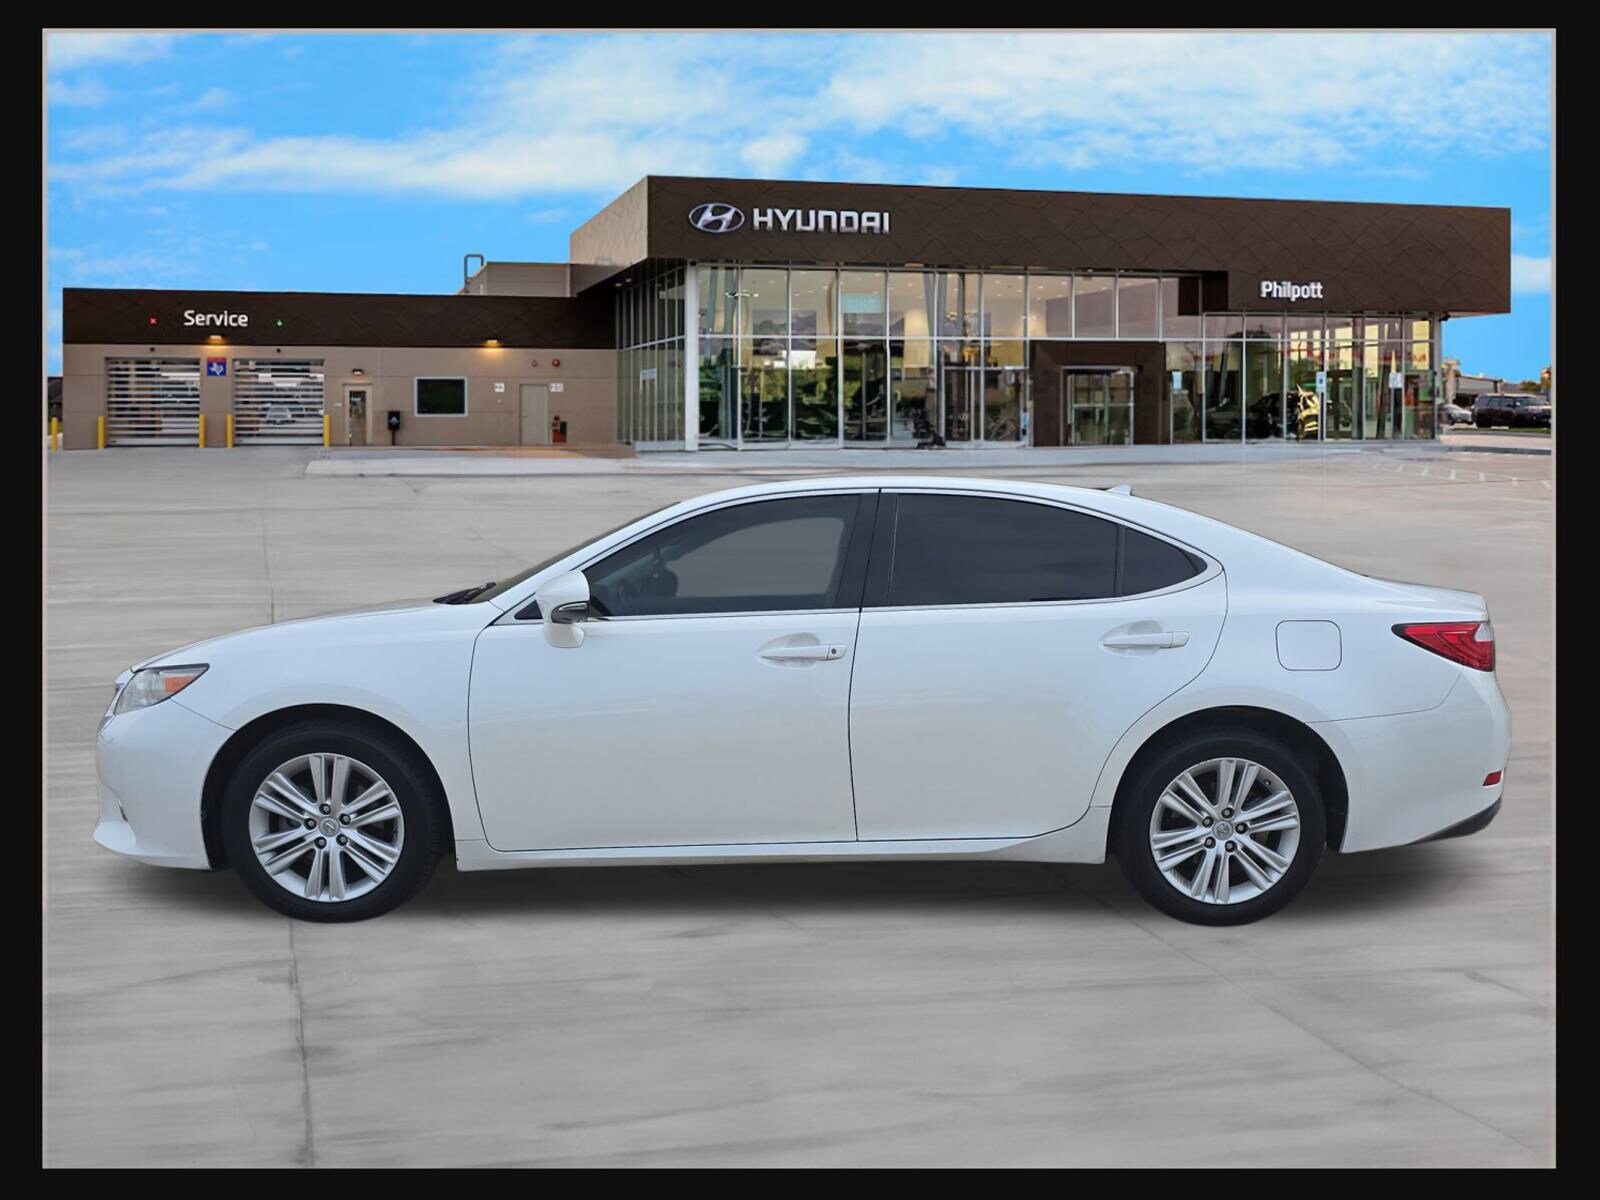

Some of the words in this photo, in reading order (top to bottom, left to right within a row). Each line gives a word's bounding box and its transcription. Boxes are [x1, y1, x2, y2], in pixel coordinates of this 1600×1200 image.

[752, 207, 890, 234] HYUNDAI
[1260, 280, 1323, 302] Philpott
[183, 309, 249, 327] Service
